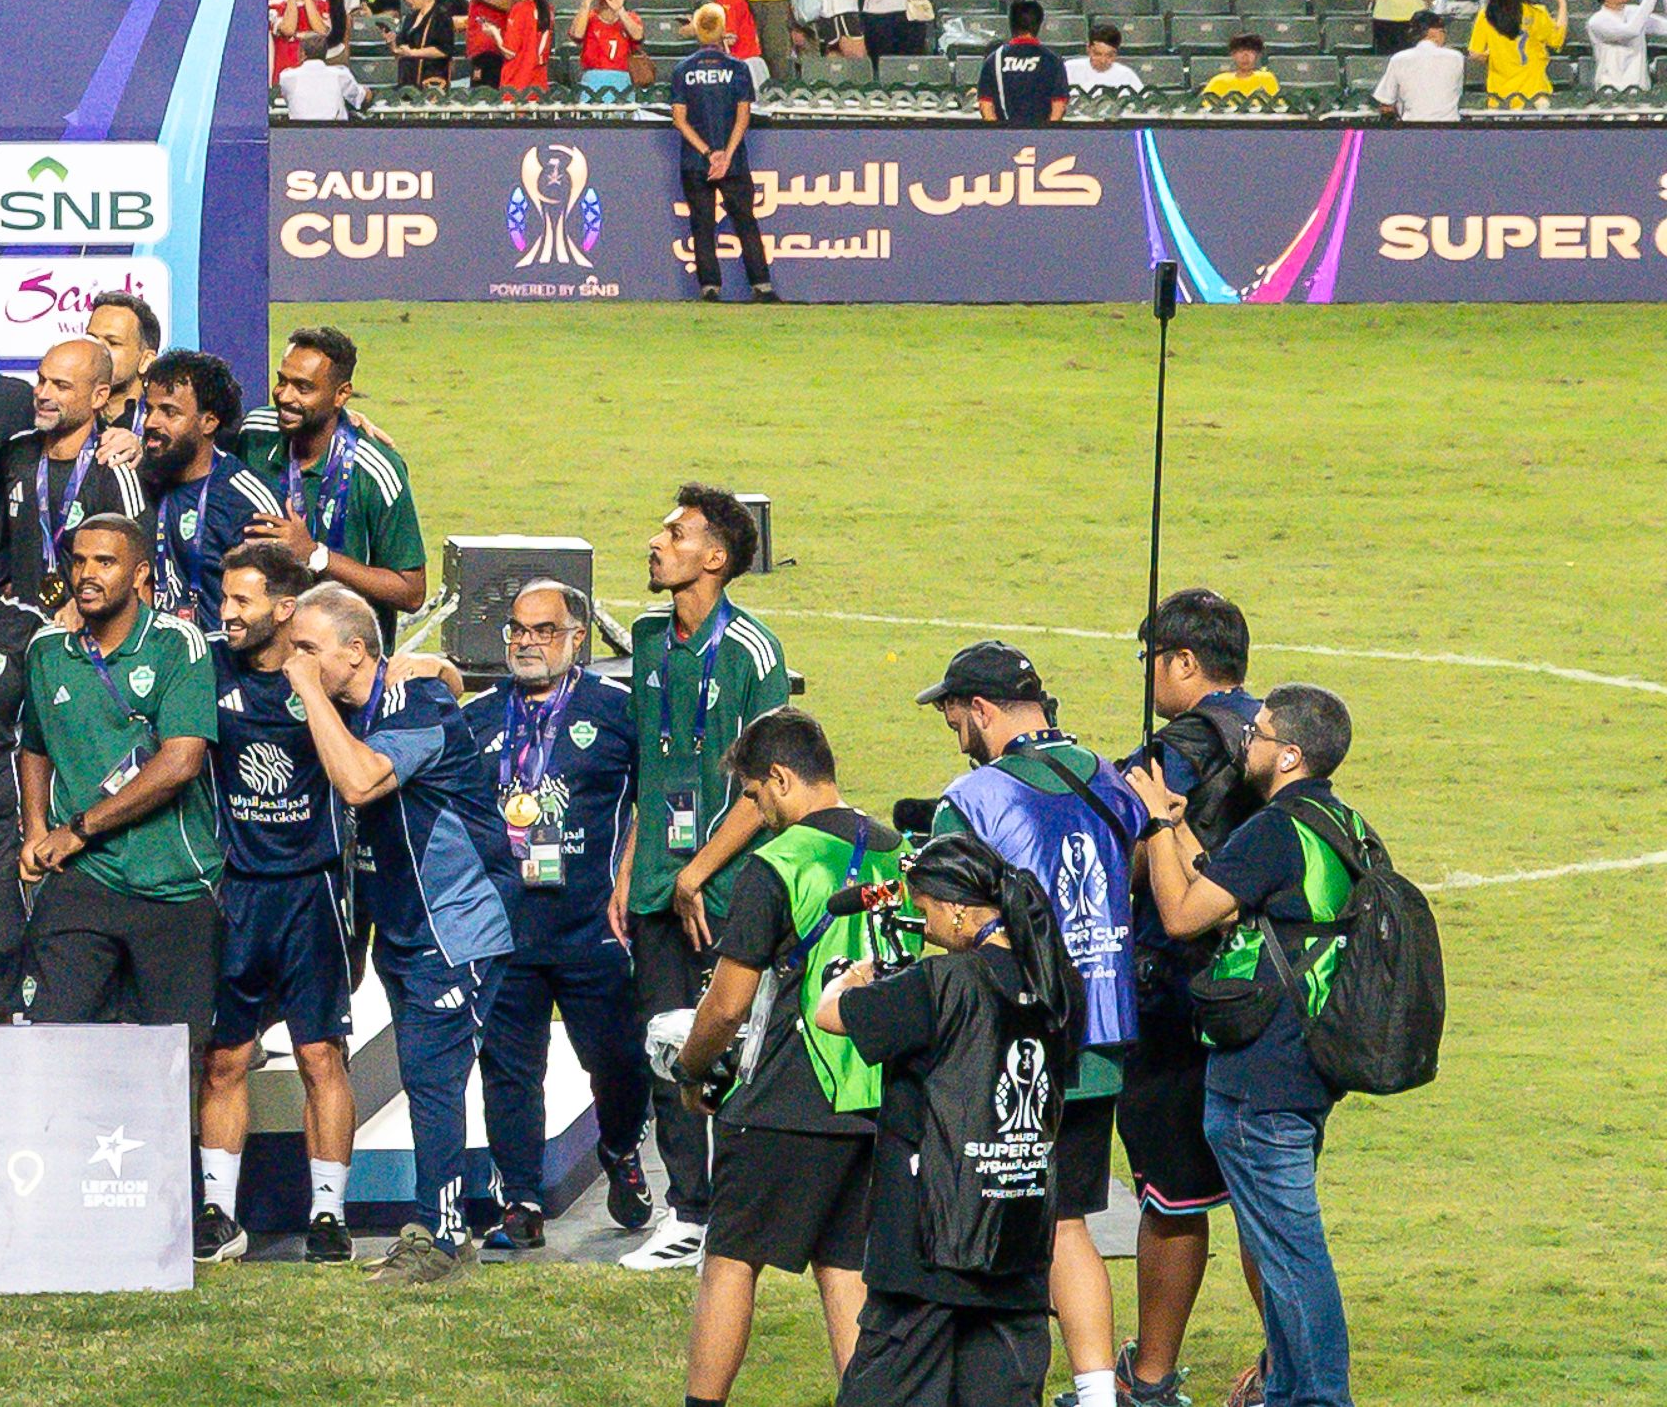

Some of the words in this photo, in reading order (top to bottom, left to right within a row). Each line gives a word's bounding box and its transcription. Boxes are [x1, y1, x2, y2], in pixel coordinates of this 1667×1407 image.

[685, 69, 734, 85] CREW
[285, 169, 434, 201] SAUDI
[908, 146, 1103, 216] كأس
[0, 191, 155, 231] SNB
[279, 212, 439, 260] CUP
[1378, 214, 1643, 262] SUPER
[489, 284, 557, 296] POWERED
[559, 284, 576, 296] BY
[579, 283, 620, 297] SNB
[251, 809, 271, 822] Sea
[273, 808, 310, 823] Global
[1092, 925, 1129, 941] CUP
[964, 1141, 1030, 1158] SUPER
[83, 1195, 146, 1208] SPORTS
